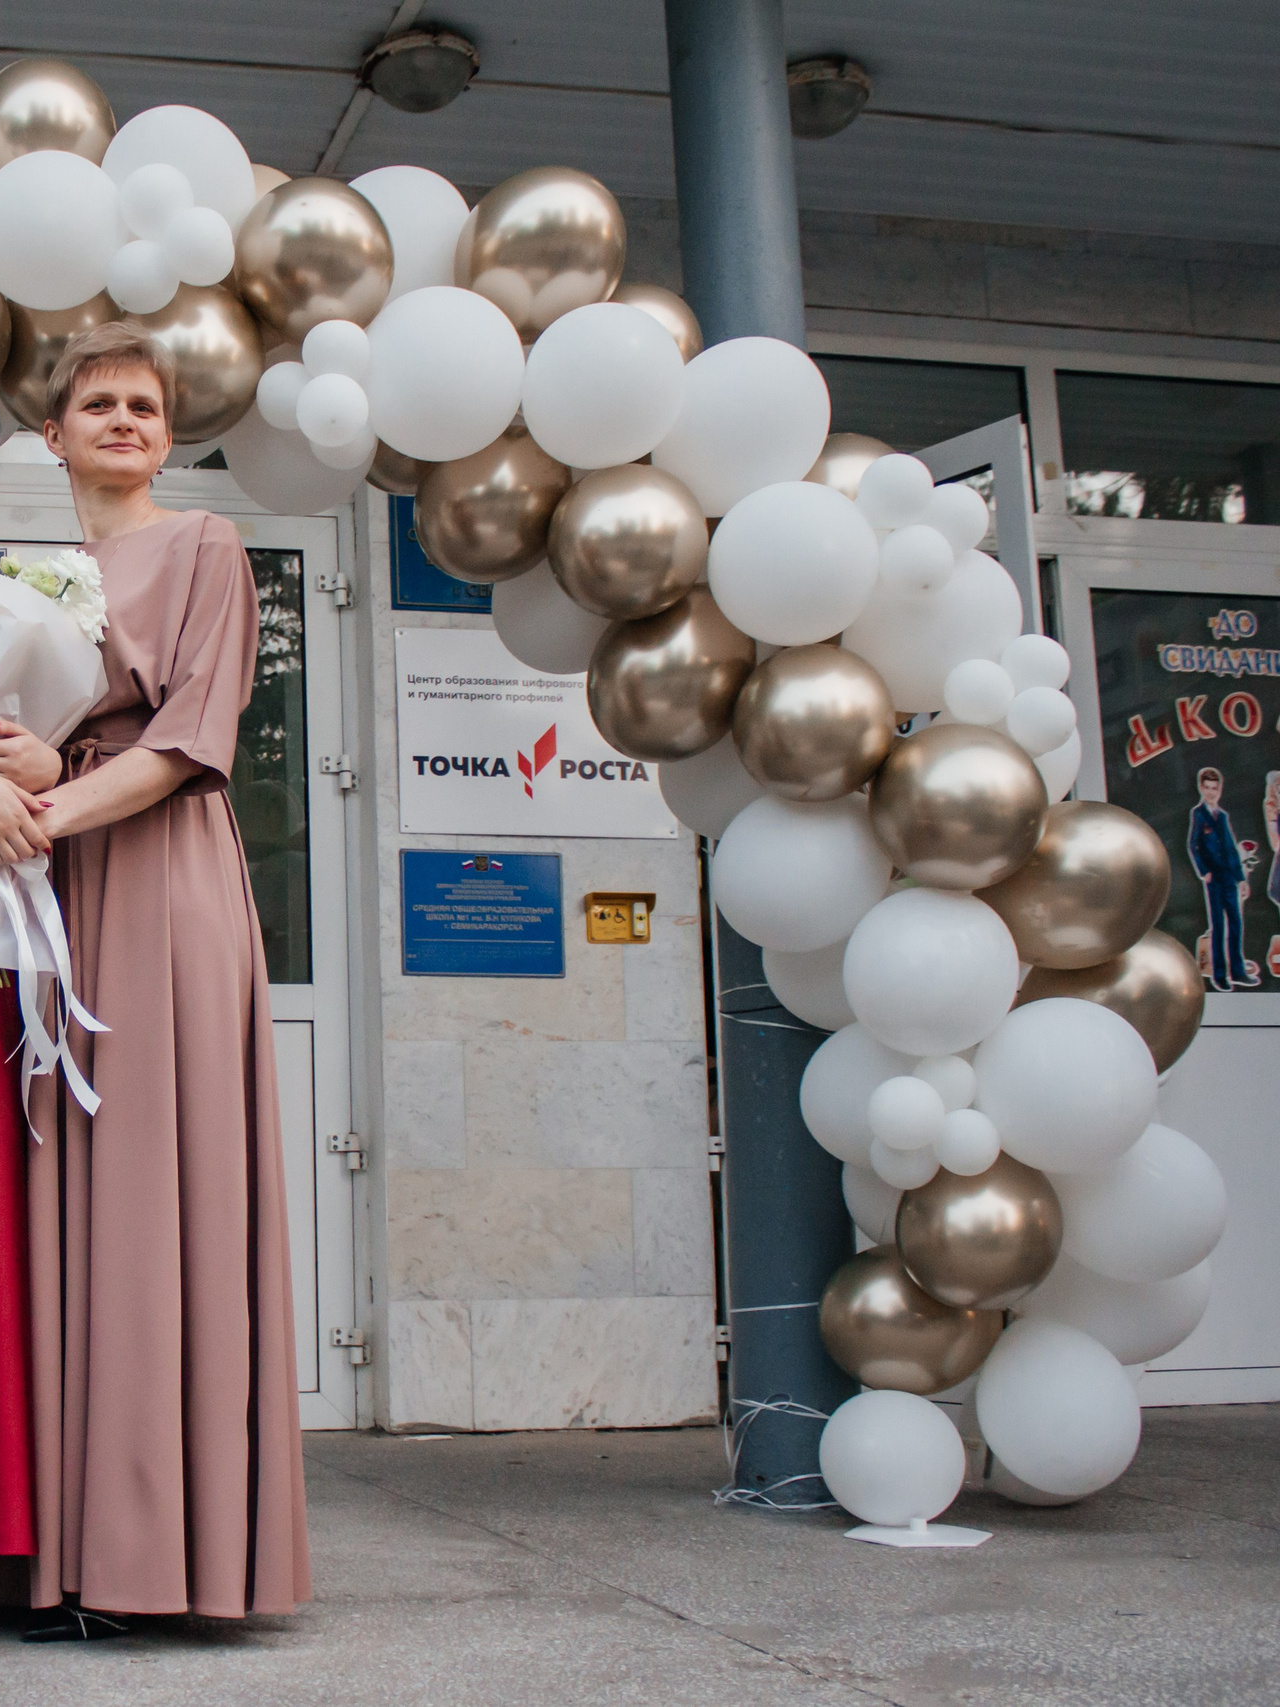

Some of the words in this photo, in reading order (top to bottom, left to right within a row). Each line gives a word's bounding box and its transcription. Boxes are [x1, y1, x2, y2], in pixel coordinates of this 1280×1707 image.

[1214, 608, 1257, 641] ДО
[407, 674, 442, 686] Центр
[445, 675, 518, 687] образования
[522, 677, 584, 690] цифрового
[408, 691, 415, 699] и
[418, 691, 502, 702] гуманитарного
[505, 692, 564, 704] профилей
[412, 755, 511, 778] ТОЧКА
[559, 759, 649, 782] РОСТА
[412, 904, 451, 913] СРЕДНЯЯ
[425, 913, 455, 921] ШКОЛА
